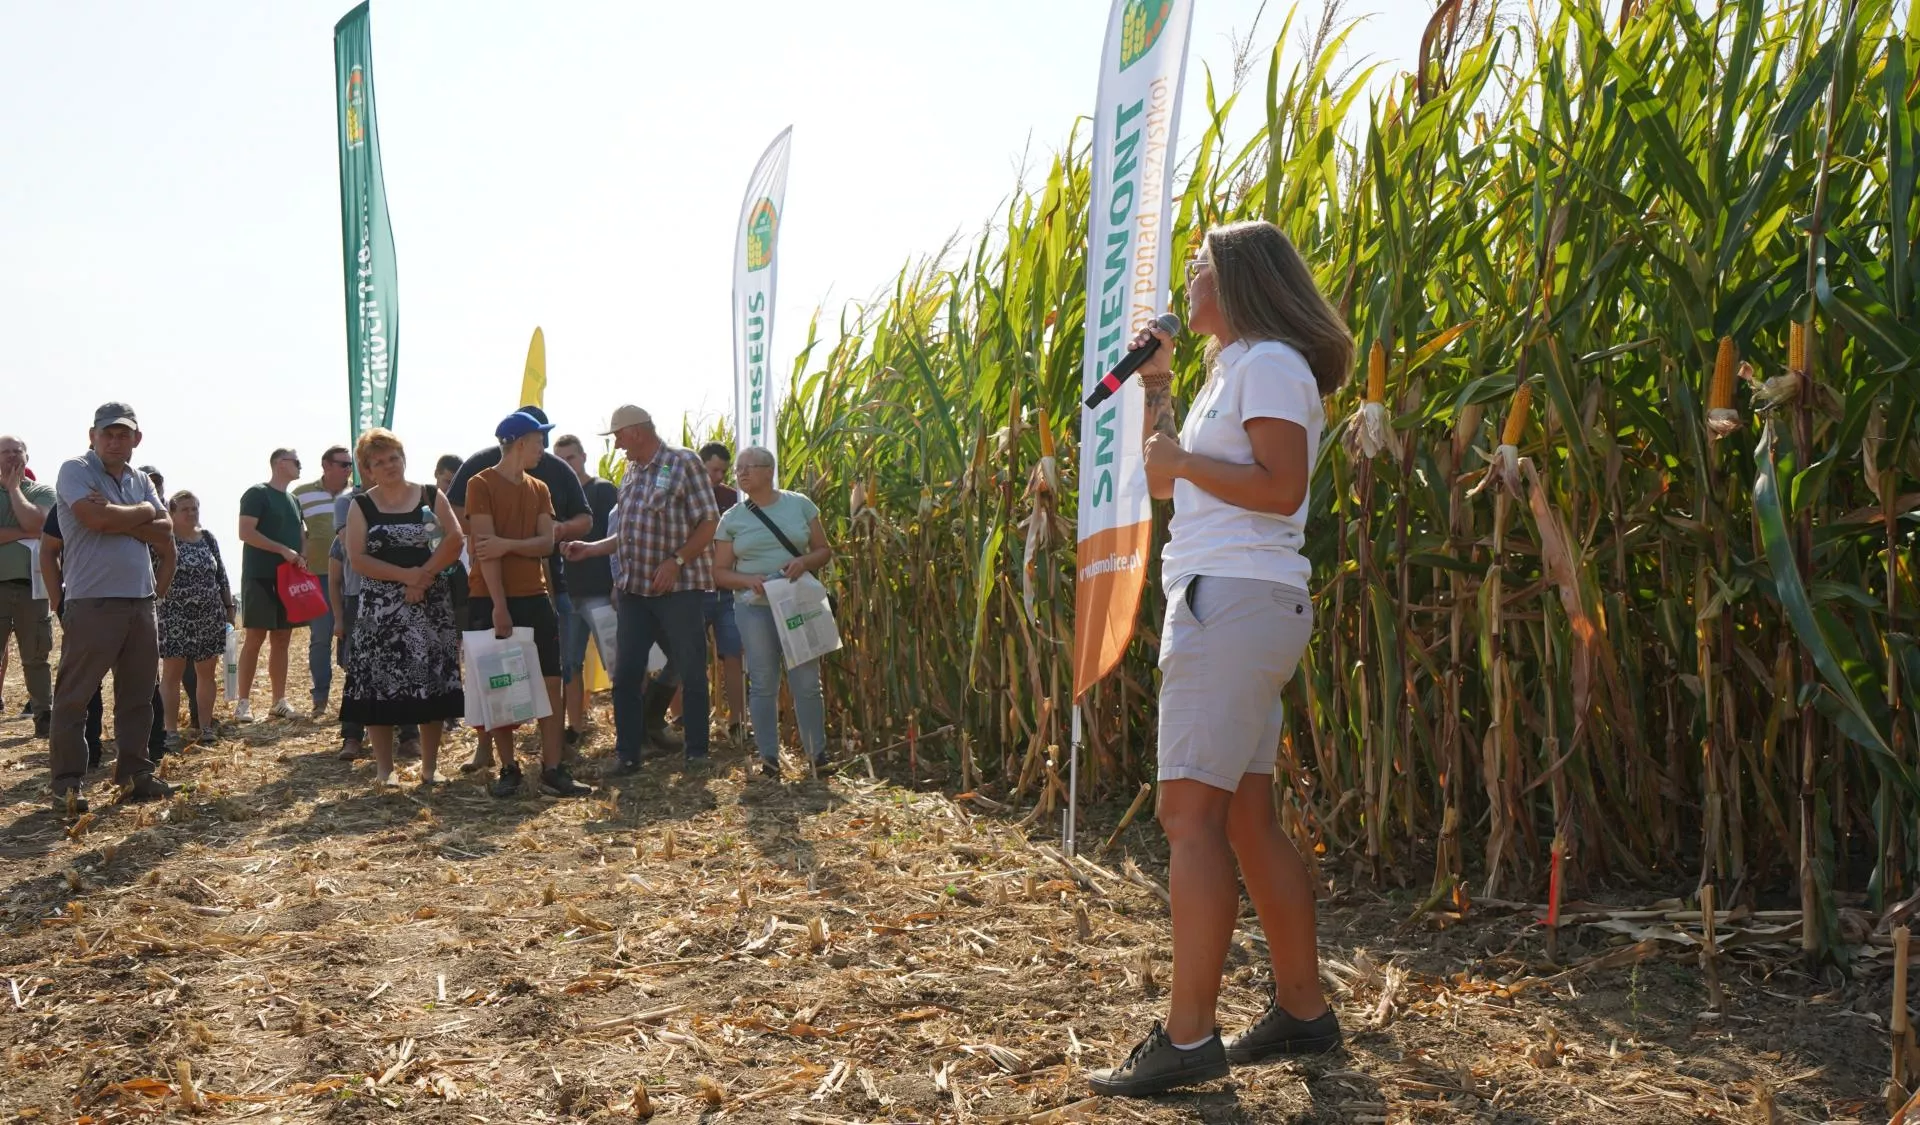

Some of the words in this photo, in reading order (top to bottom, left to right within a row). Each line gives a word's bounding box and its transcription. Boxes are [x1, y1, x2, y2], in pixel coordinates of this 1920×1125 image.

[1143, 76, 1168, 204] wszystko!
[1097, 99, 1143, 384] GIEWONT
[1134, 213, 1159, 295] ponad
[748, 291, 764, 447] ERSEUS
[1130, 303, 1153, 334] ny
[1092, 406, 1116, 508] SM
